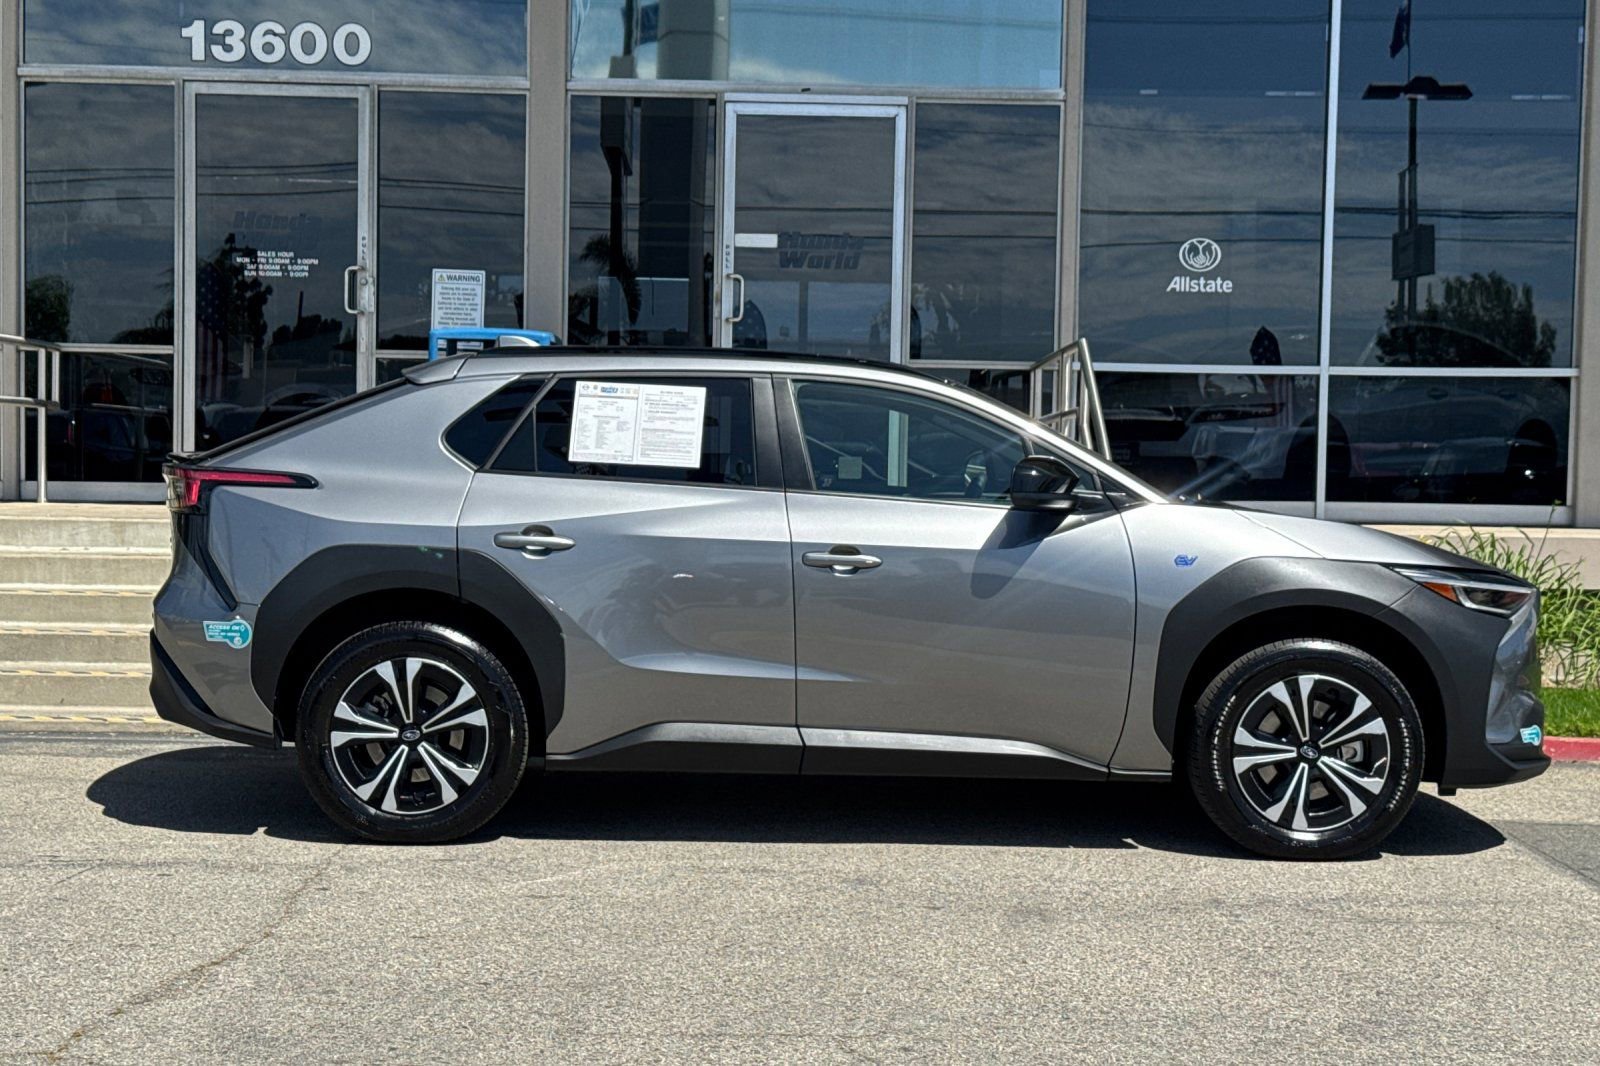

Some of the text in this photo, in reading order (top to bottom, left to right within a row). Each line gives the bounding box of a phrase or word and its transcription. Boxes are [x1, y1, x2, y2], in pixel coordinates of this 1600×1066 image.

[181, 19, 372, 66] 13600
[780, 251, 861, 270] World
[446, 273, 481, 282] WARNING
[1166, 275, 1233, 293] Allstate
[1173, 555, 1199, 567] EV
